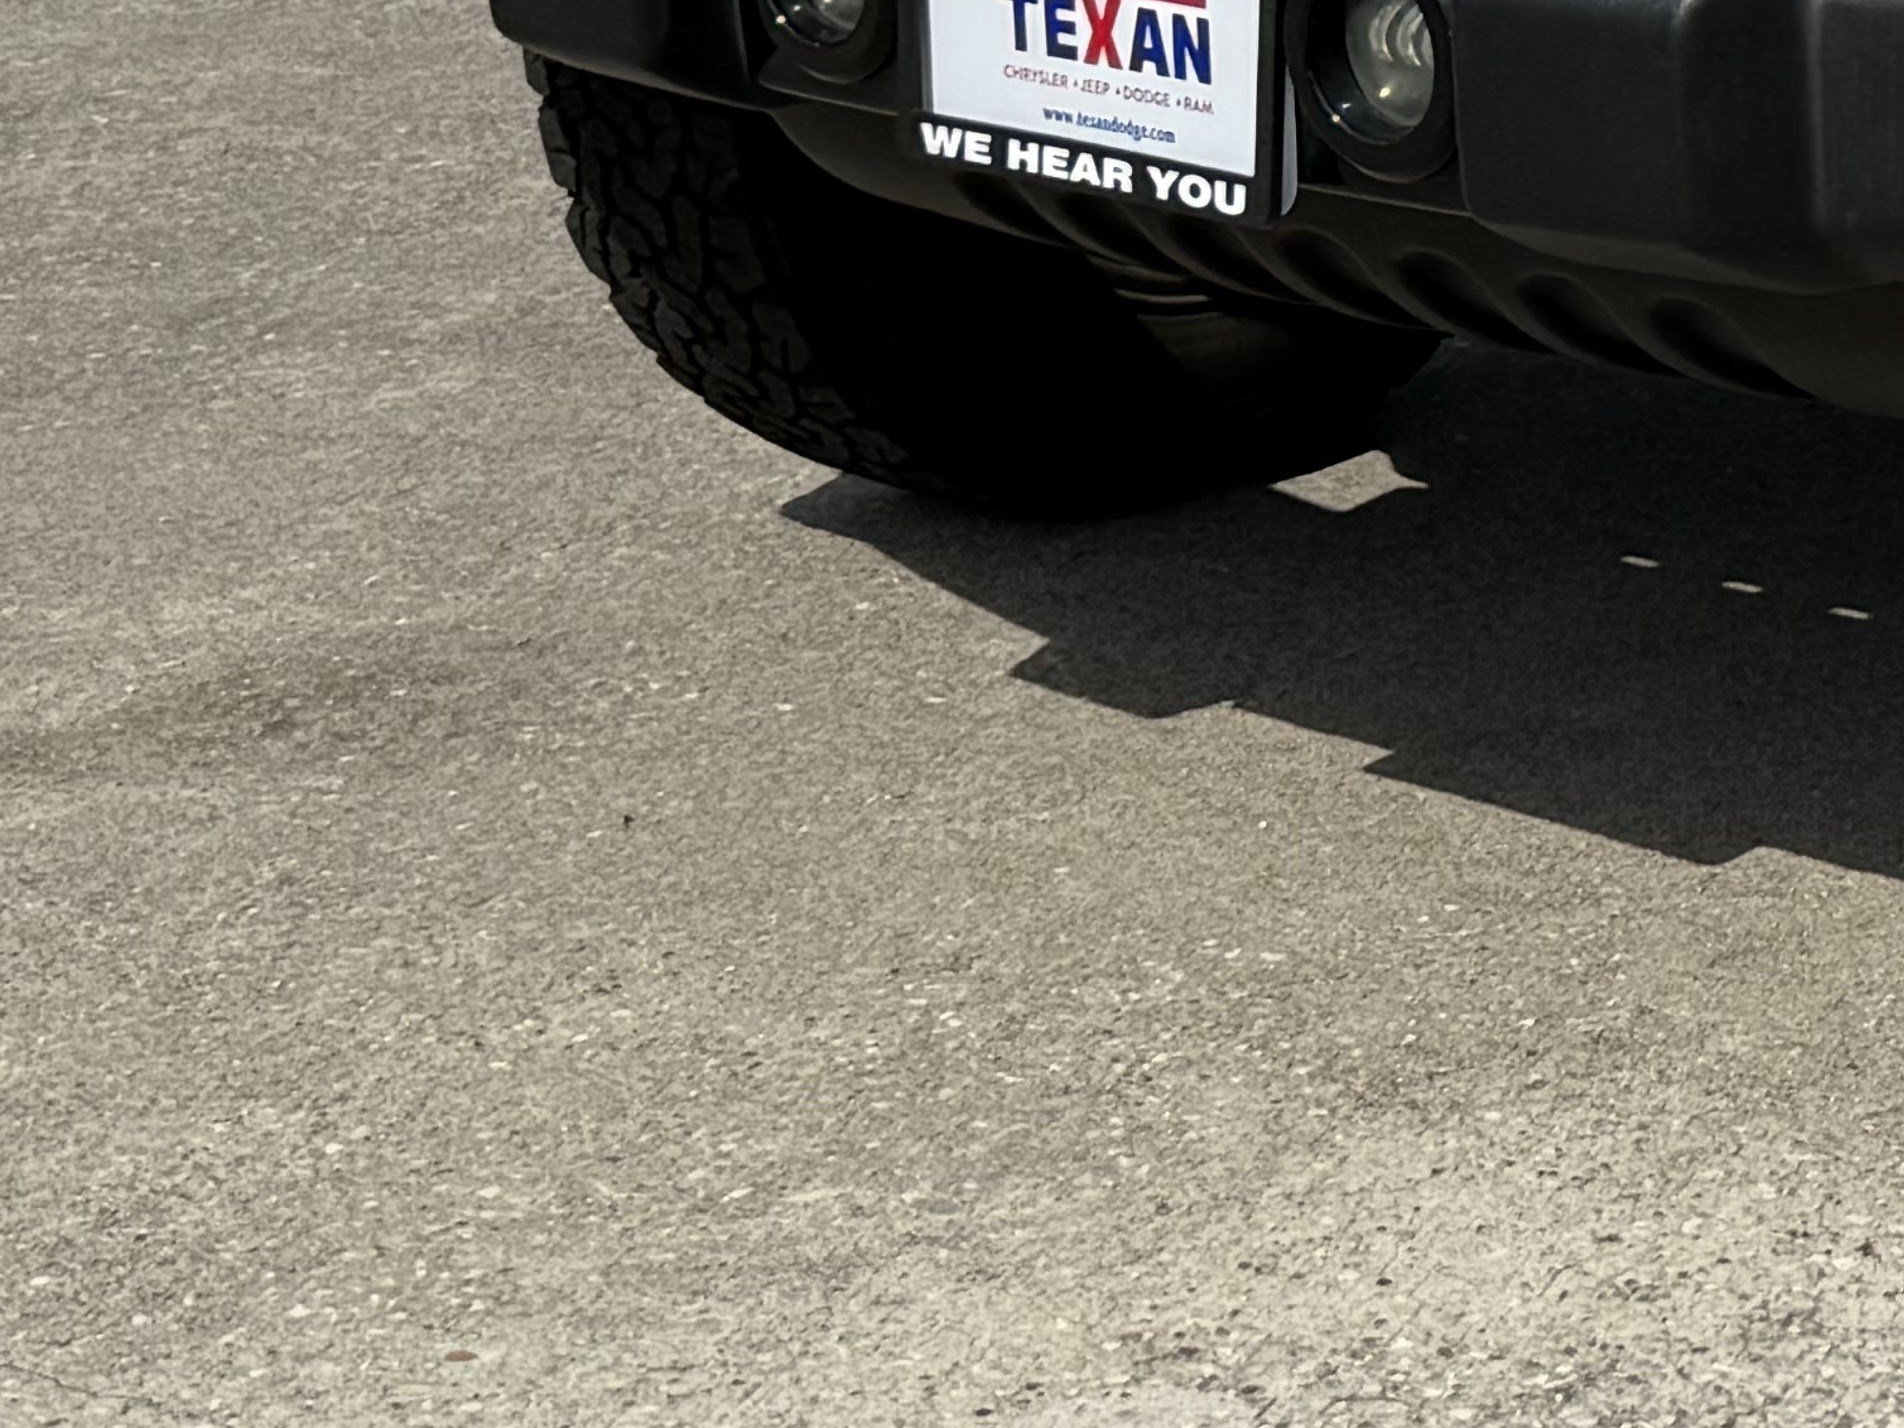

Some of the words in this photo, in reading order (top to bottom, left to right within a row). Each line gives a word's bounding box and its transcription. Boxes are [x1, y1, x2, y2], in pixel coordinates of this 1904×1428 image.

[1003, 64, 1069, 90] CHRYSLER
[1081, 79, 1111, 96] JEEP
[1122, 85, 1171, 108] DODGE
[1183, 96, 1215, 115] RAM
[919, 123, 992, 166] WE
[1006, 138, 1134, 194] HEAR
[1147, 166, 1248, 217] YOU
